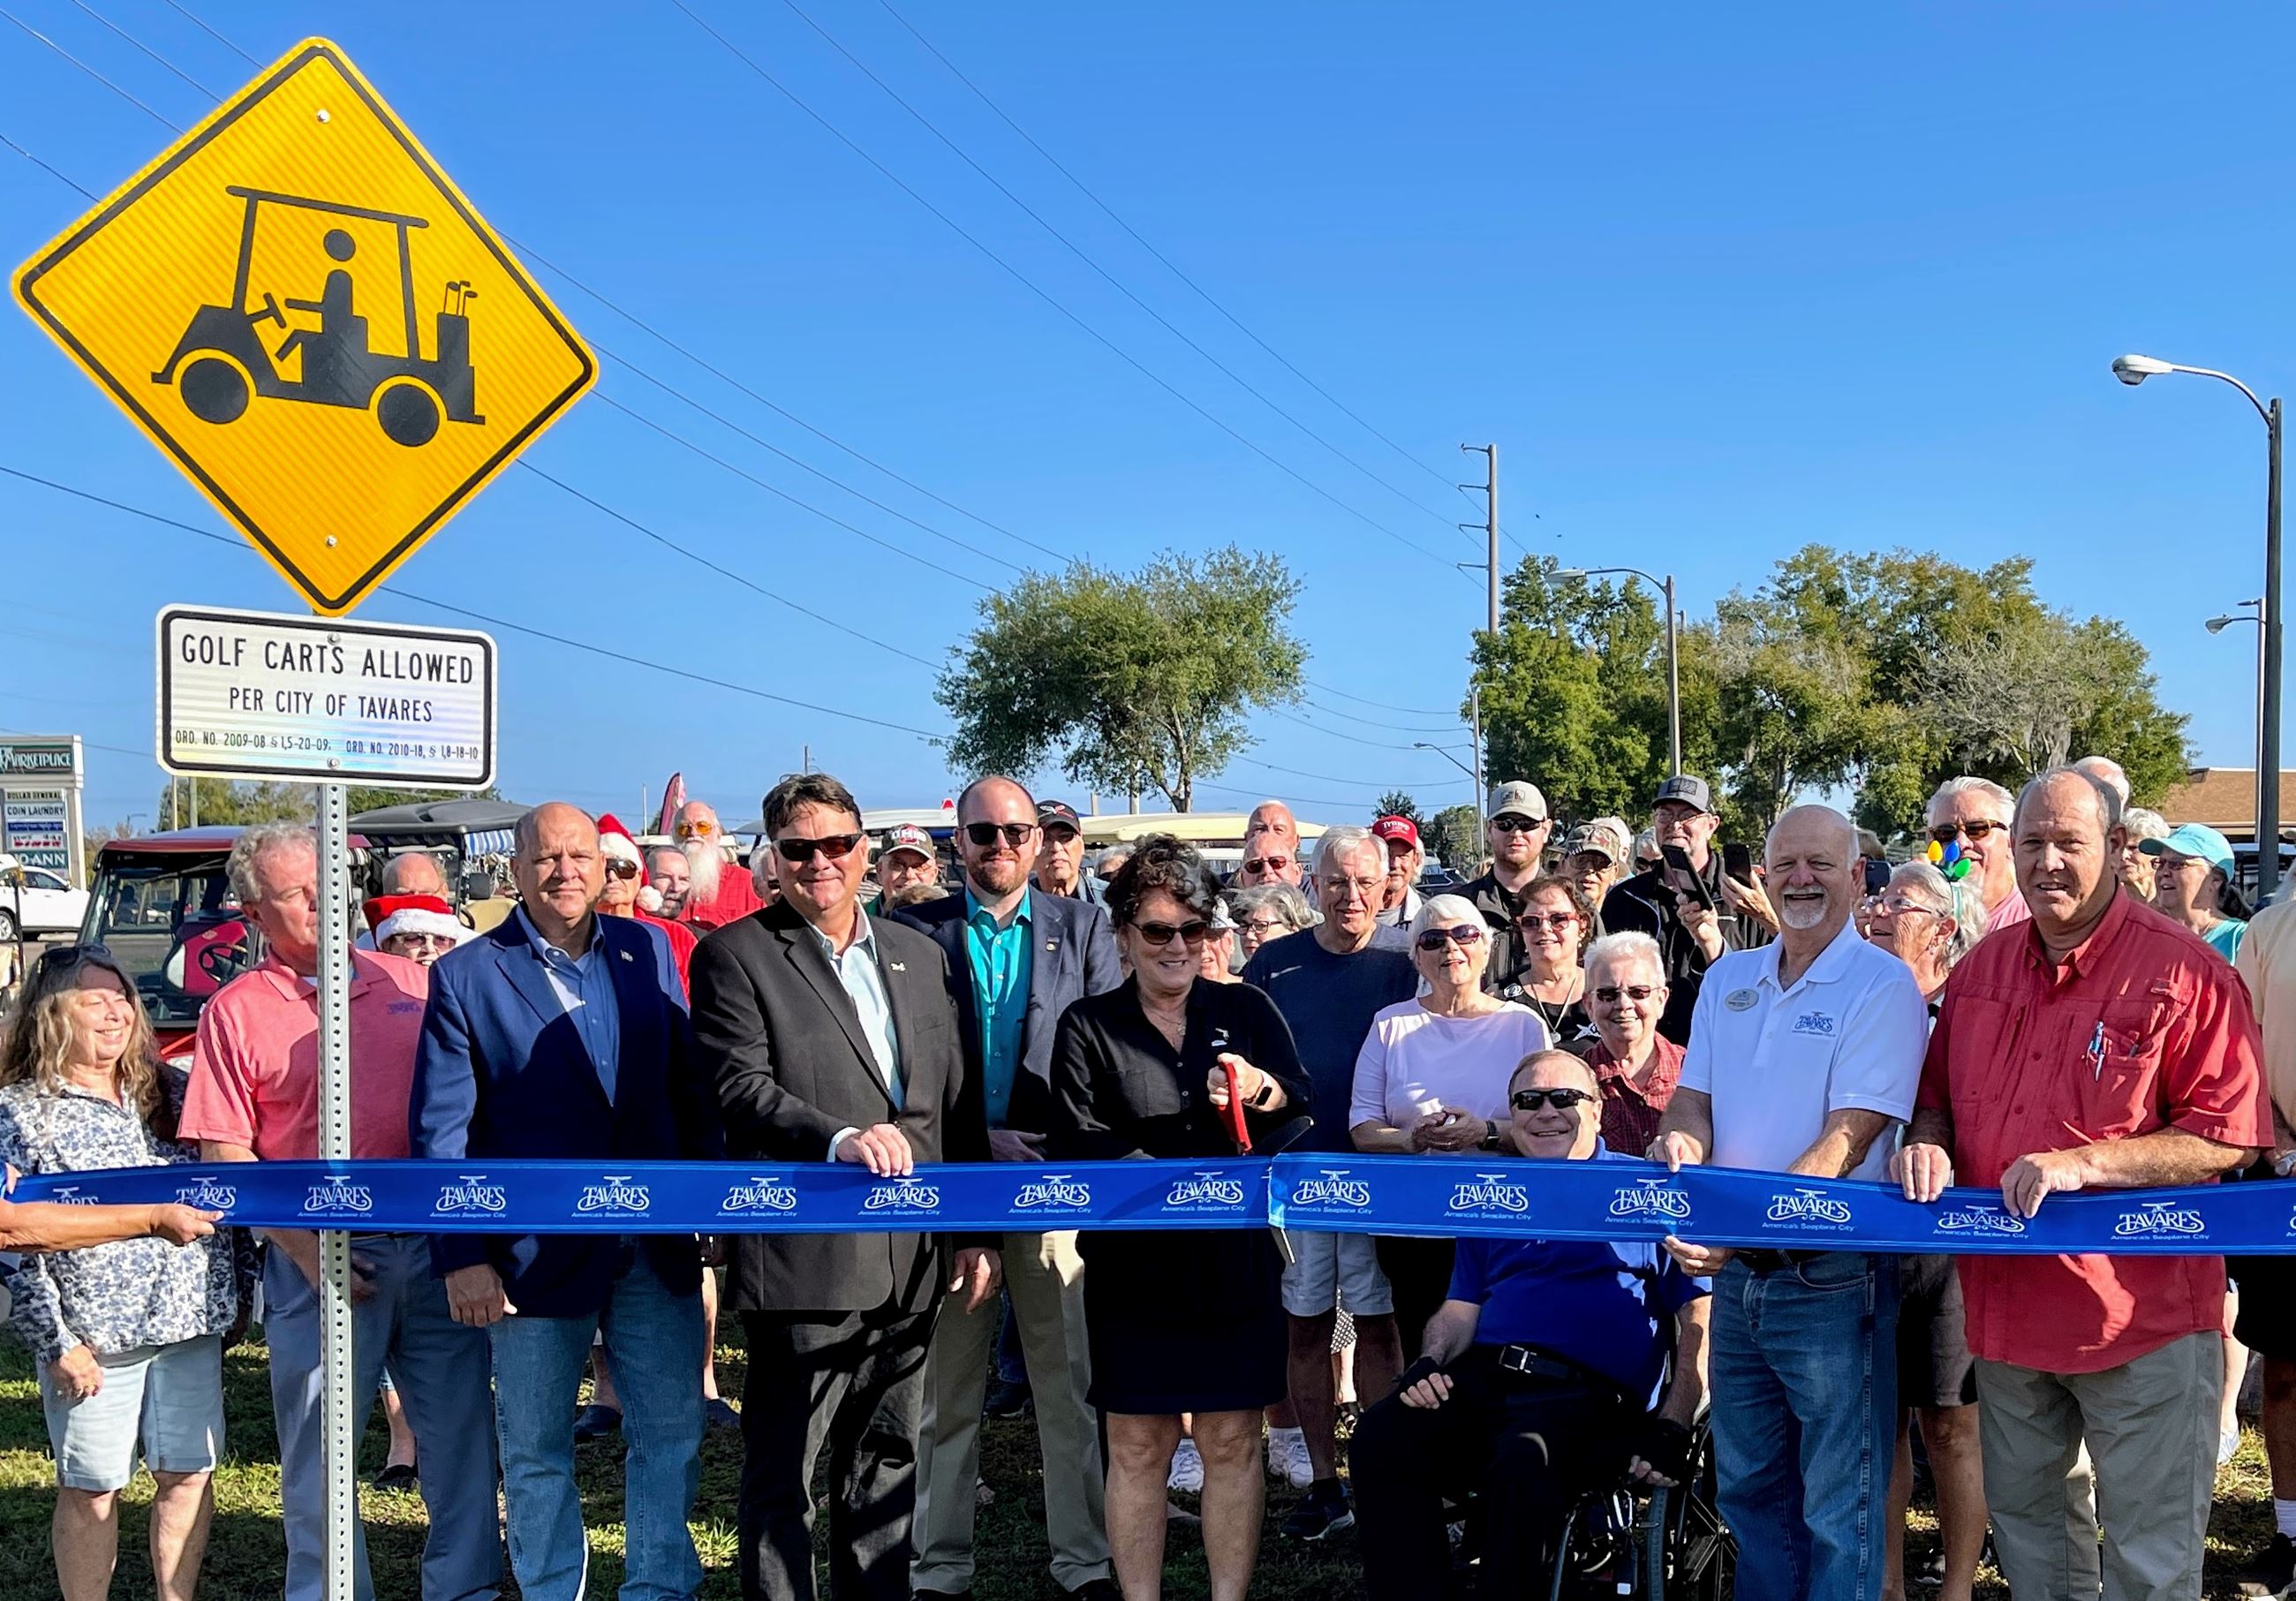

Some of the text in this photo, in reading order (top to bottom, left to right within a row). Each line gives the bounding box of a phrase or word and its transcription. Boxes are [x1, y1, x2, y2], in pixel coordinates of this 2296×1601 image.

[182, 634, 472, 683] GOLF CARTS ALLOWED
[230, 687, 432, 722] PER CITY OF TAVARES
[176, 730, 198, 745] ORD.
[203, 731, 218, 745] NO.
[223, 733, 266, 749] 2009-08
[346, 740, 366, 754] ORD.
[370, 742, 383, 754] NO.
[389, 743, 426, 759] 2010-18,
[7, 806, 64, 816] COIN LAUNDRY
[305, 1187, 372, 1211] TAVARES
[436, 1187, 506, 1211] TAVARES
[578, 1187, 650, 1211] TAVARES
[722, 1187, 797, 1210] TAVARES
[865, 1187, 939, 1209] TAVARES
[1015, 1183, 1090, 1207] TAVARES
[1167, 1181, 1243, 1205] TAVARES
[1293, 1181, 1370, 1206] TAVARES
[1450, 1184, 1528, 1212] TAVARES
[1610, 1189, 1691, 1218] TAVARES
[1767, 1195, 1851, 1223] TAVARES
[1937, 1212, 2025, 1233] TAVARES
[2115, 1211, 2205, 1235] TAVARES
